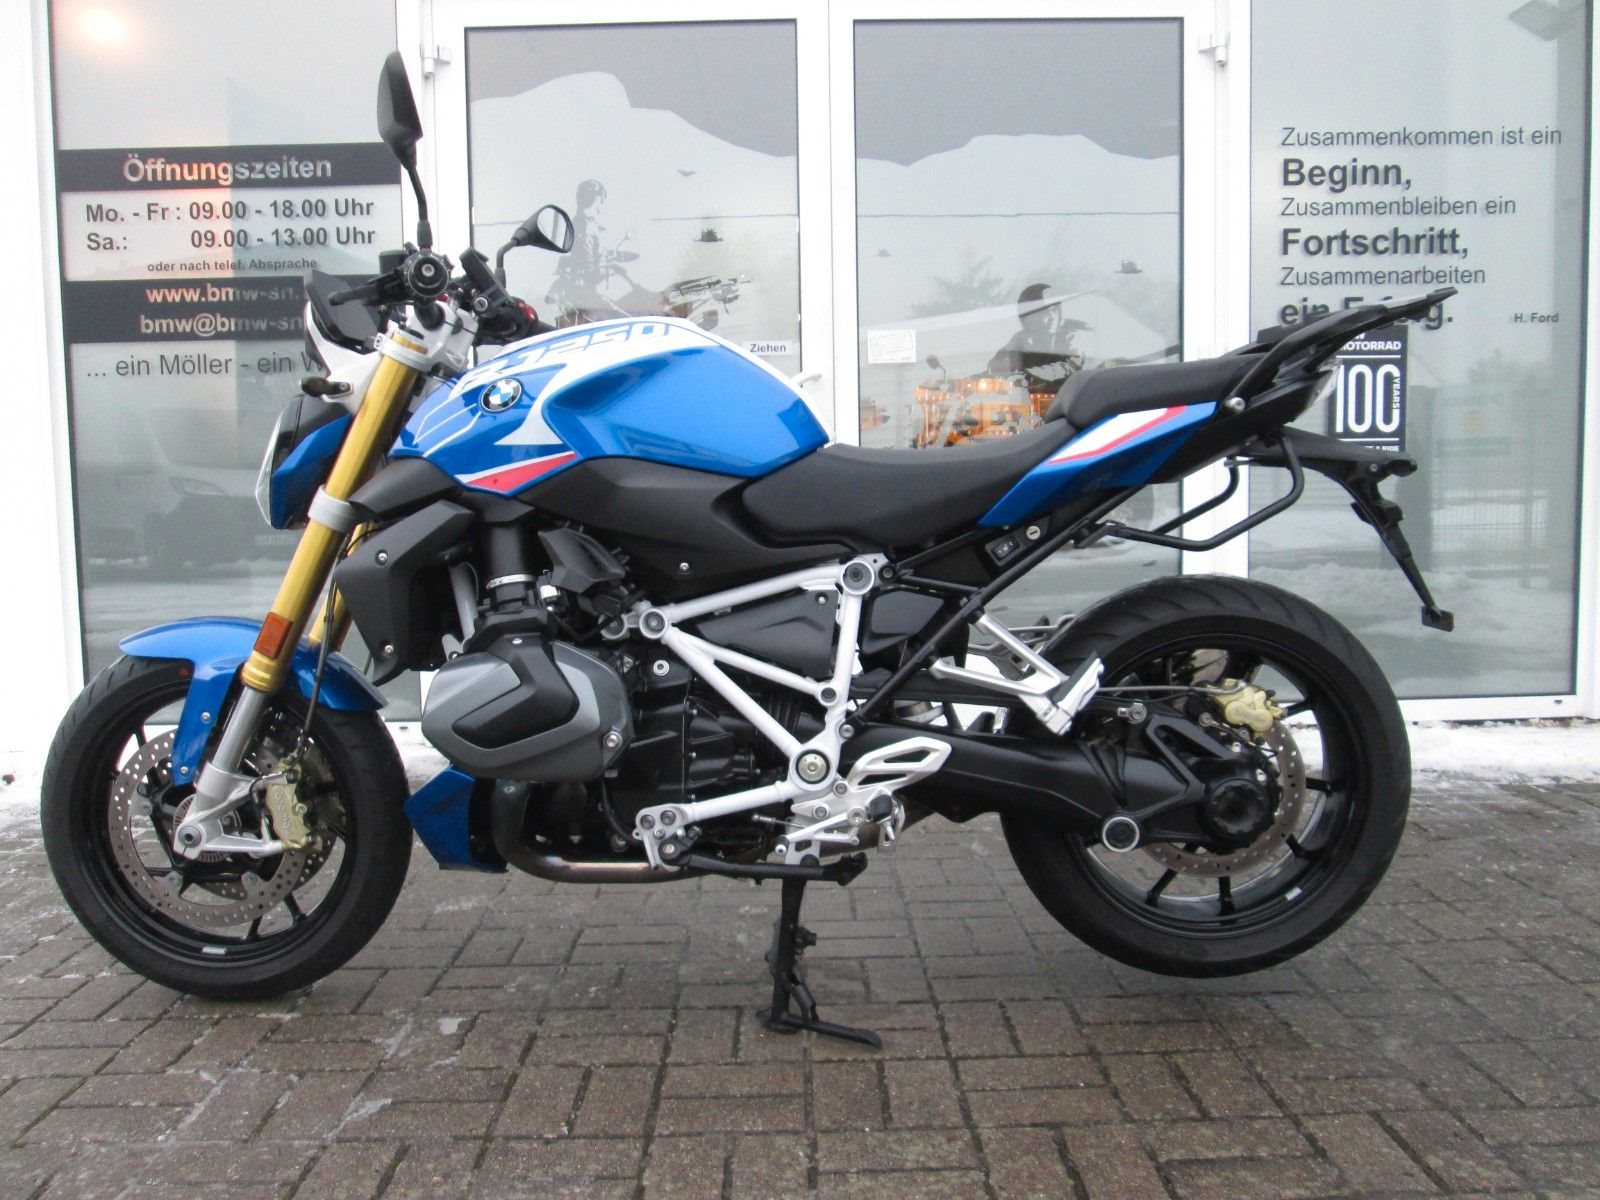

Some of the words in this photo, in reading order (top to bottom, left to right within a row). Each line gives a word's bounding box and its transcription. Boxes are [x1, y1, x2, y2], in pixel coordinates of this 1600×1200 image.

[1281, 127, 1492, 146] Zusammenkommen
[1501, 126, 1524, 145] ist
[1532, 126, 1562, 145] ein
[123, 154, 332, 186] Öffnungszeiten
[1283, 158, 1411, 193] Beginn,
[86, 203, 125, 223] Mo.
[189, 200, 247, 220] 09.00
[270, 199, 326, 219] 18.00
[335, 198, 374, 217] Uhr
[1281, 197, 1477, 216] Zusammenbleiben
[1485, 197, 1516, 215] ein
[86, 232, 128, 251] Sa.:
[190, 229, 249, 248] 09.00
[271, 227, 328, 247] 13.00
[336, 226, 376, 245] Uhr
[1282, 227, 1468, 260] Fortschritt,
[147, 261, 175, 272] oder
[179, 260, 211, 271] nach
[214, 259, 246, 271] telef.
[249, 257, 318, 273] Absprache
[1280, 266, 1486, 286] Zusammenarbeiten
[146, 283, 300, 303] www.bmw-sn.
[140, 312, 303, 336] bmw@bmw-sn
[1514, 313, 1526, 323] H.
[1531, 312, 1559, 323] Ford
[750, 343, 786, 353] Ziehen
[115, 356, 151, 375] ein
[160, 354, 233, 375] Möller
[257, 352, 293, 373] ein
[300, 351, 323, 372] W
[1335, 364, 1400, 433] 100
